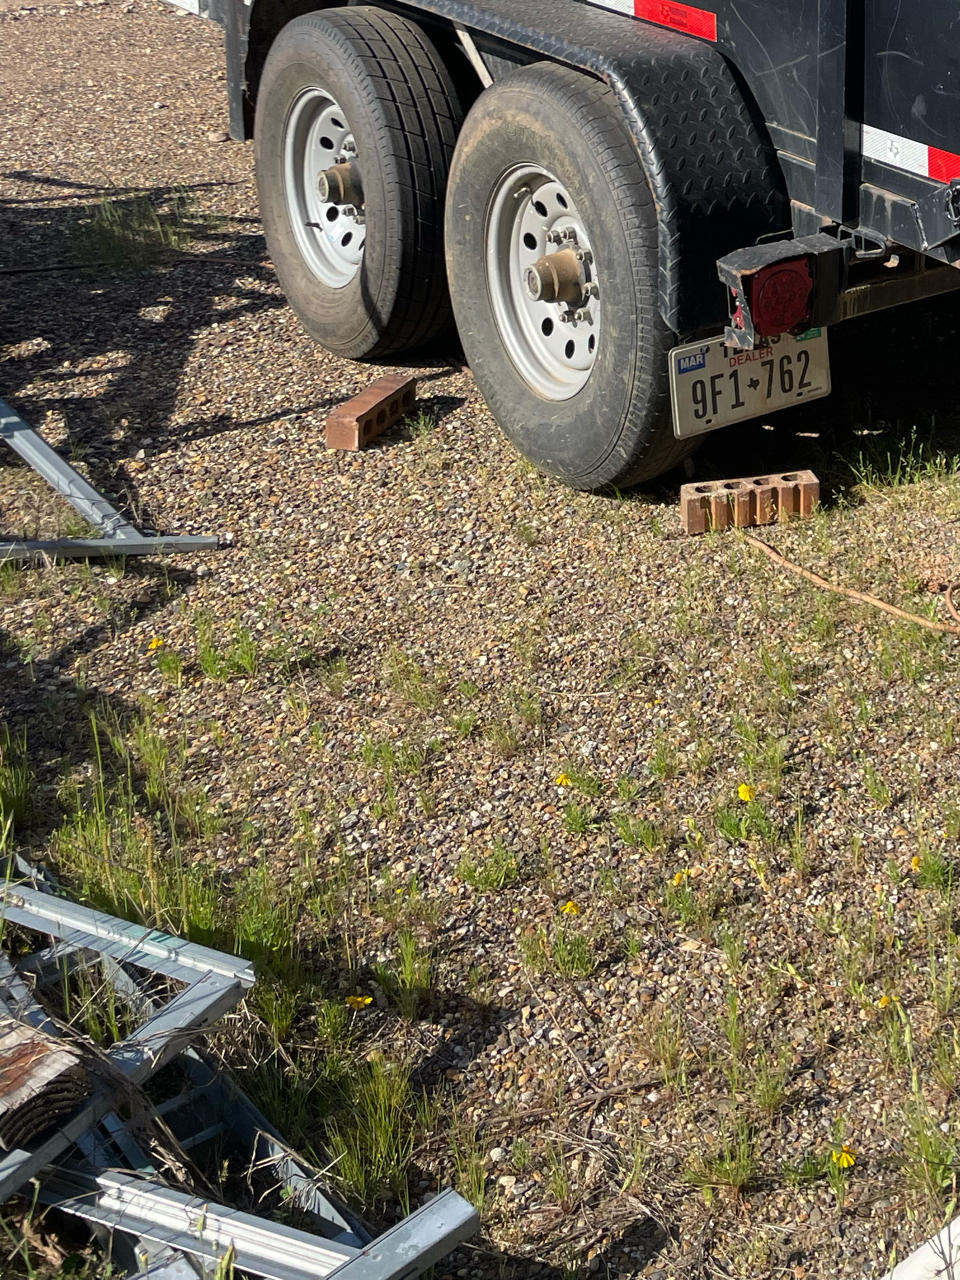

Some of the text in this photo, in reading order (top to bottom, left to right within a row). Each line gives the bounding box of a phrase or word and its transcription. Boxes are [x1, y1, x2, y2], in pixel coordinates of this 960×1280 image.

[680, 355, 704, 370] MAR
[729, 347, 774, 368] DEALER
[692, 350, 812, 420] 9F1 762
